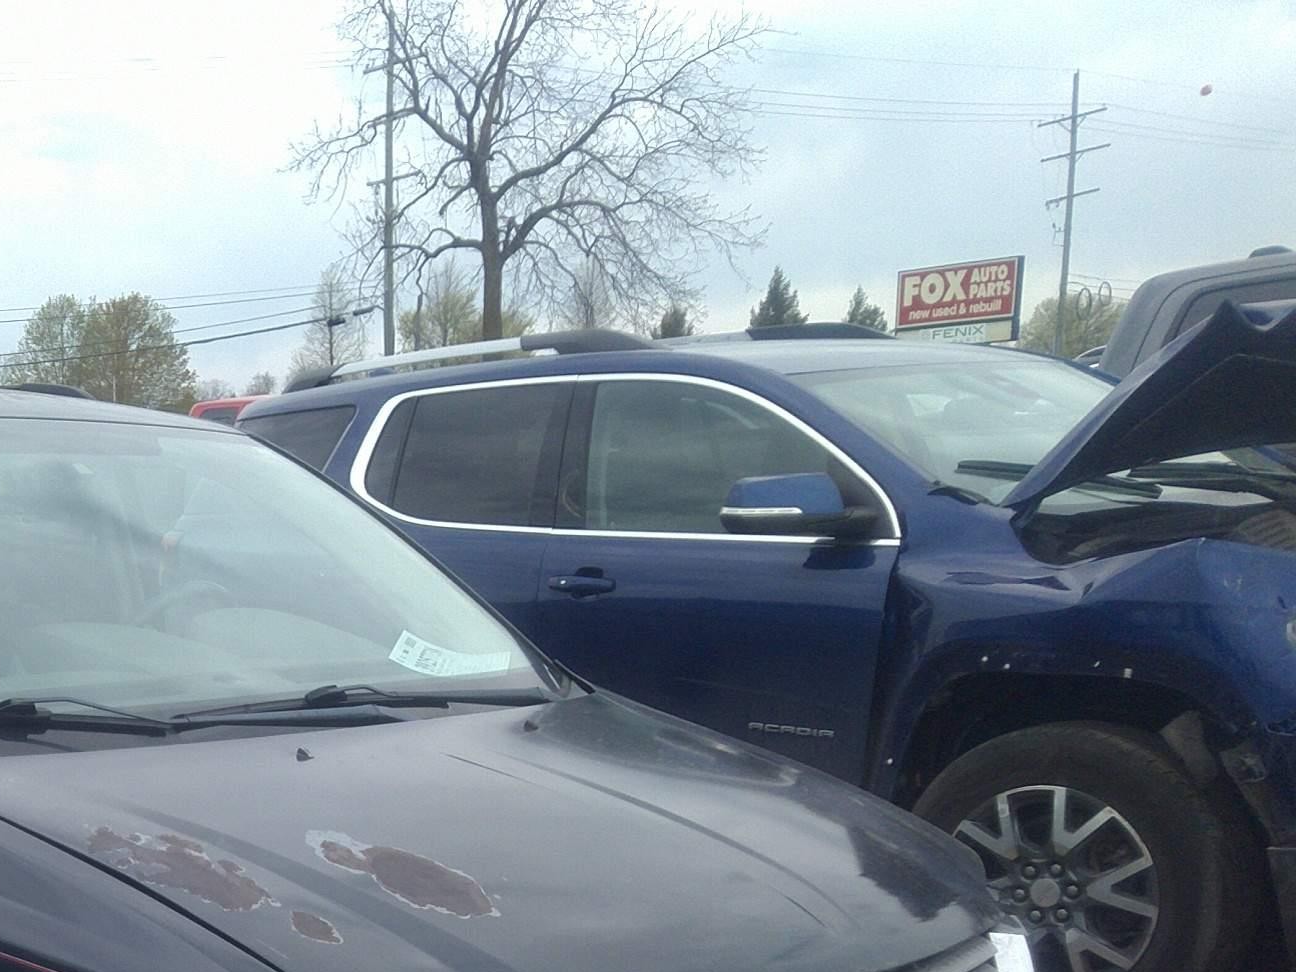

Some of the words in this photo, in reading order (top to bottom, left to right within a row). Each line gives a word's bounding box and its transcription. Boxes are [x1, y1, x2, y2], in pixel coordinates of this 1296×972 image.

[971, 265, 1008, 283] AUTO
[904, 269, 968, 306] FOX
[969, 281, 1011, 299] PARTS
[909, 308, 930, 321] new
[932, 303, 957, 318] used
[959, 303, 967, 314] &
[969, 299, 1002, 313] rebuilt
[932, 325, 984, 340] FENIX
[748, 722, 835, 737] ACADIA
